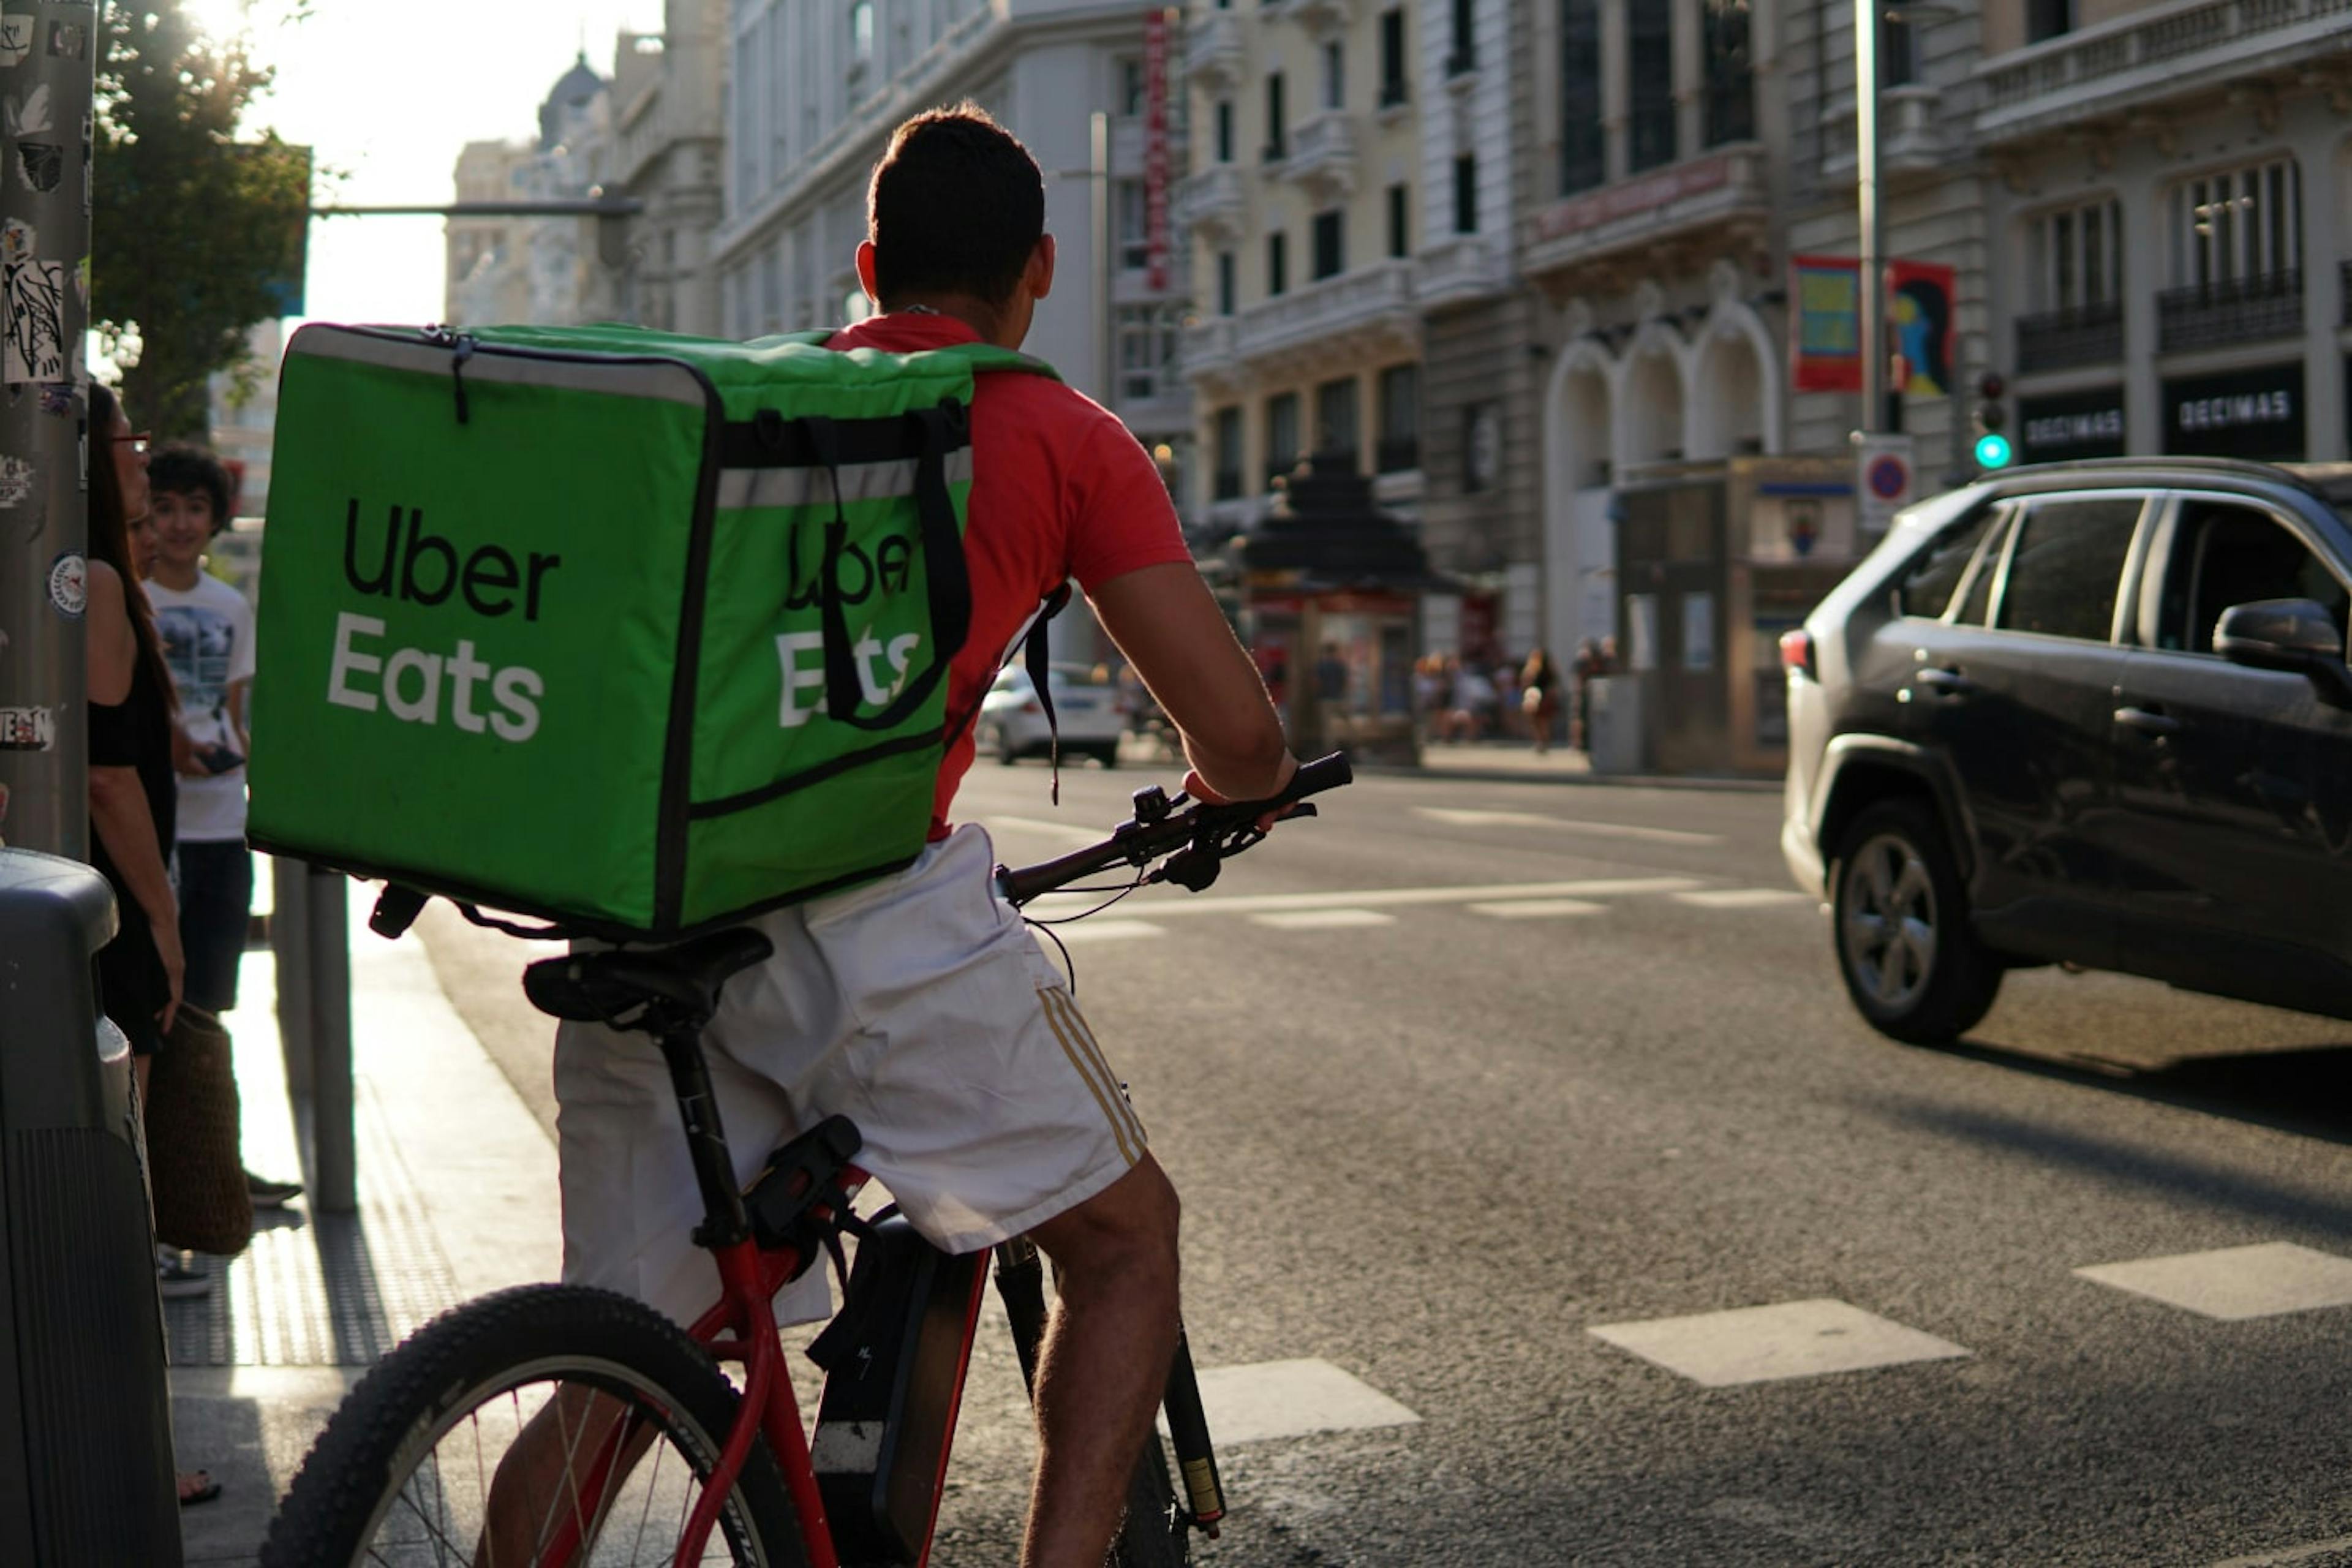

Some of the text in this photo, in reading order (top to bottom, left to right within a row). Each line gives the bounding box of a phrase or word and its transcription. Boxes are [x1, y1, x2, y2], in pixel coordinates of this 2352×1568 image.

[2179, 390, 2290, 428] DECIMAS
[344, 498, 561, 622] Uber
[326, 611, 545, 743] Eats
[775, 624, 921, 728] Ets
